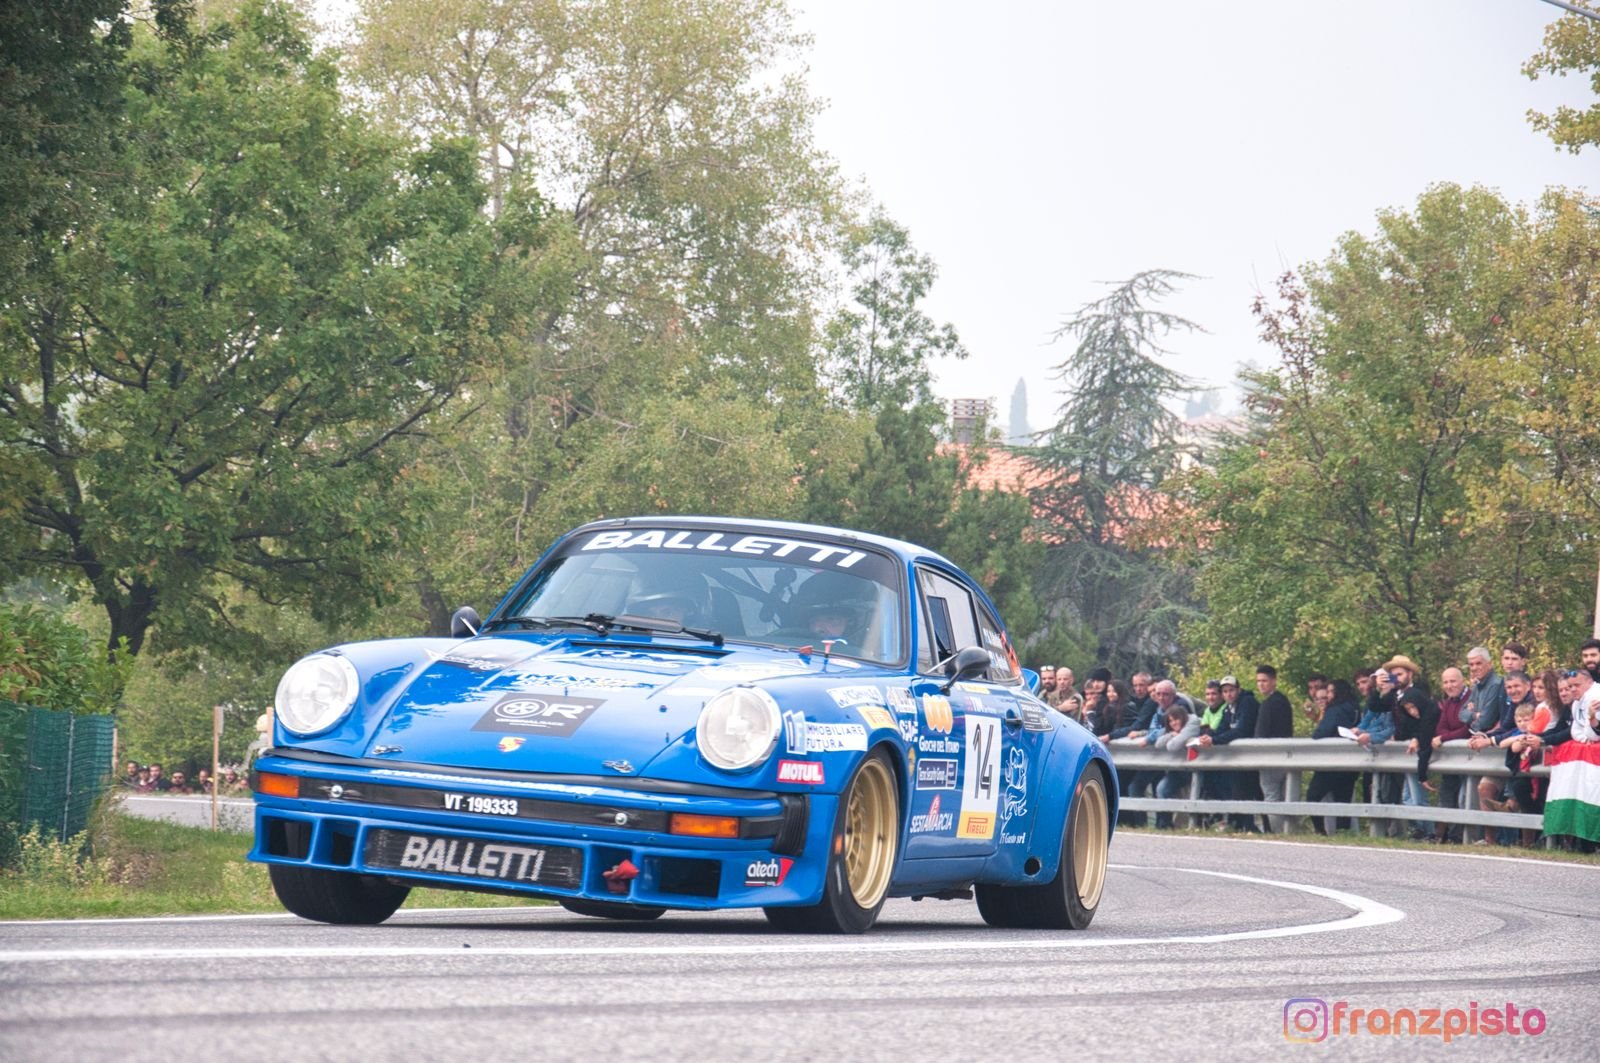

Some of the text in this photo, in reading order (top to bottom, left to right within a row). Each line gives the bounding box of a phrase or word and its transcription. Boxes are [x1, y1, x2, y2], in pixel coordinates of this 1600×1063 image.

[580, 531, 867, 568] BALLETTI
[806, 737, 844, 749] FUTURA
[972, 723, 994, 800] 14
[778, 762, 822, 782] MOTUL
[966, 816, 989, 835] PIRELLI
[400, 836, 546, 881] BALLETTI
[747, 858, 779, 878] atech
